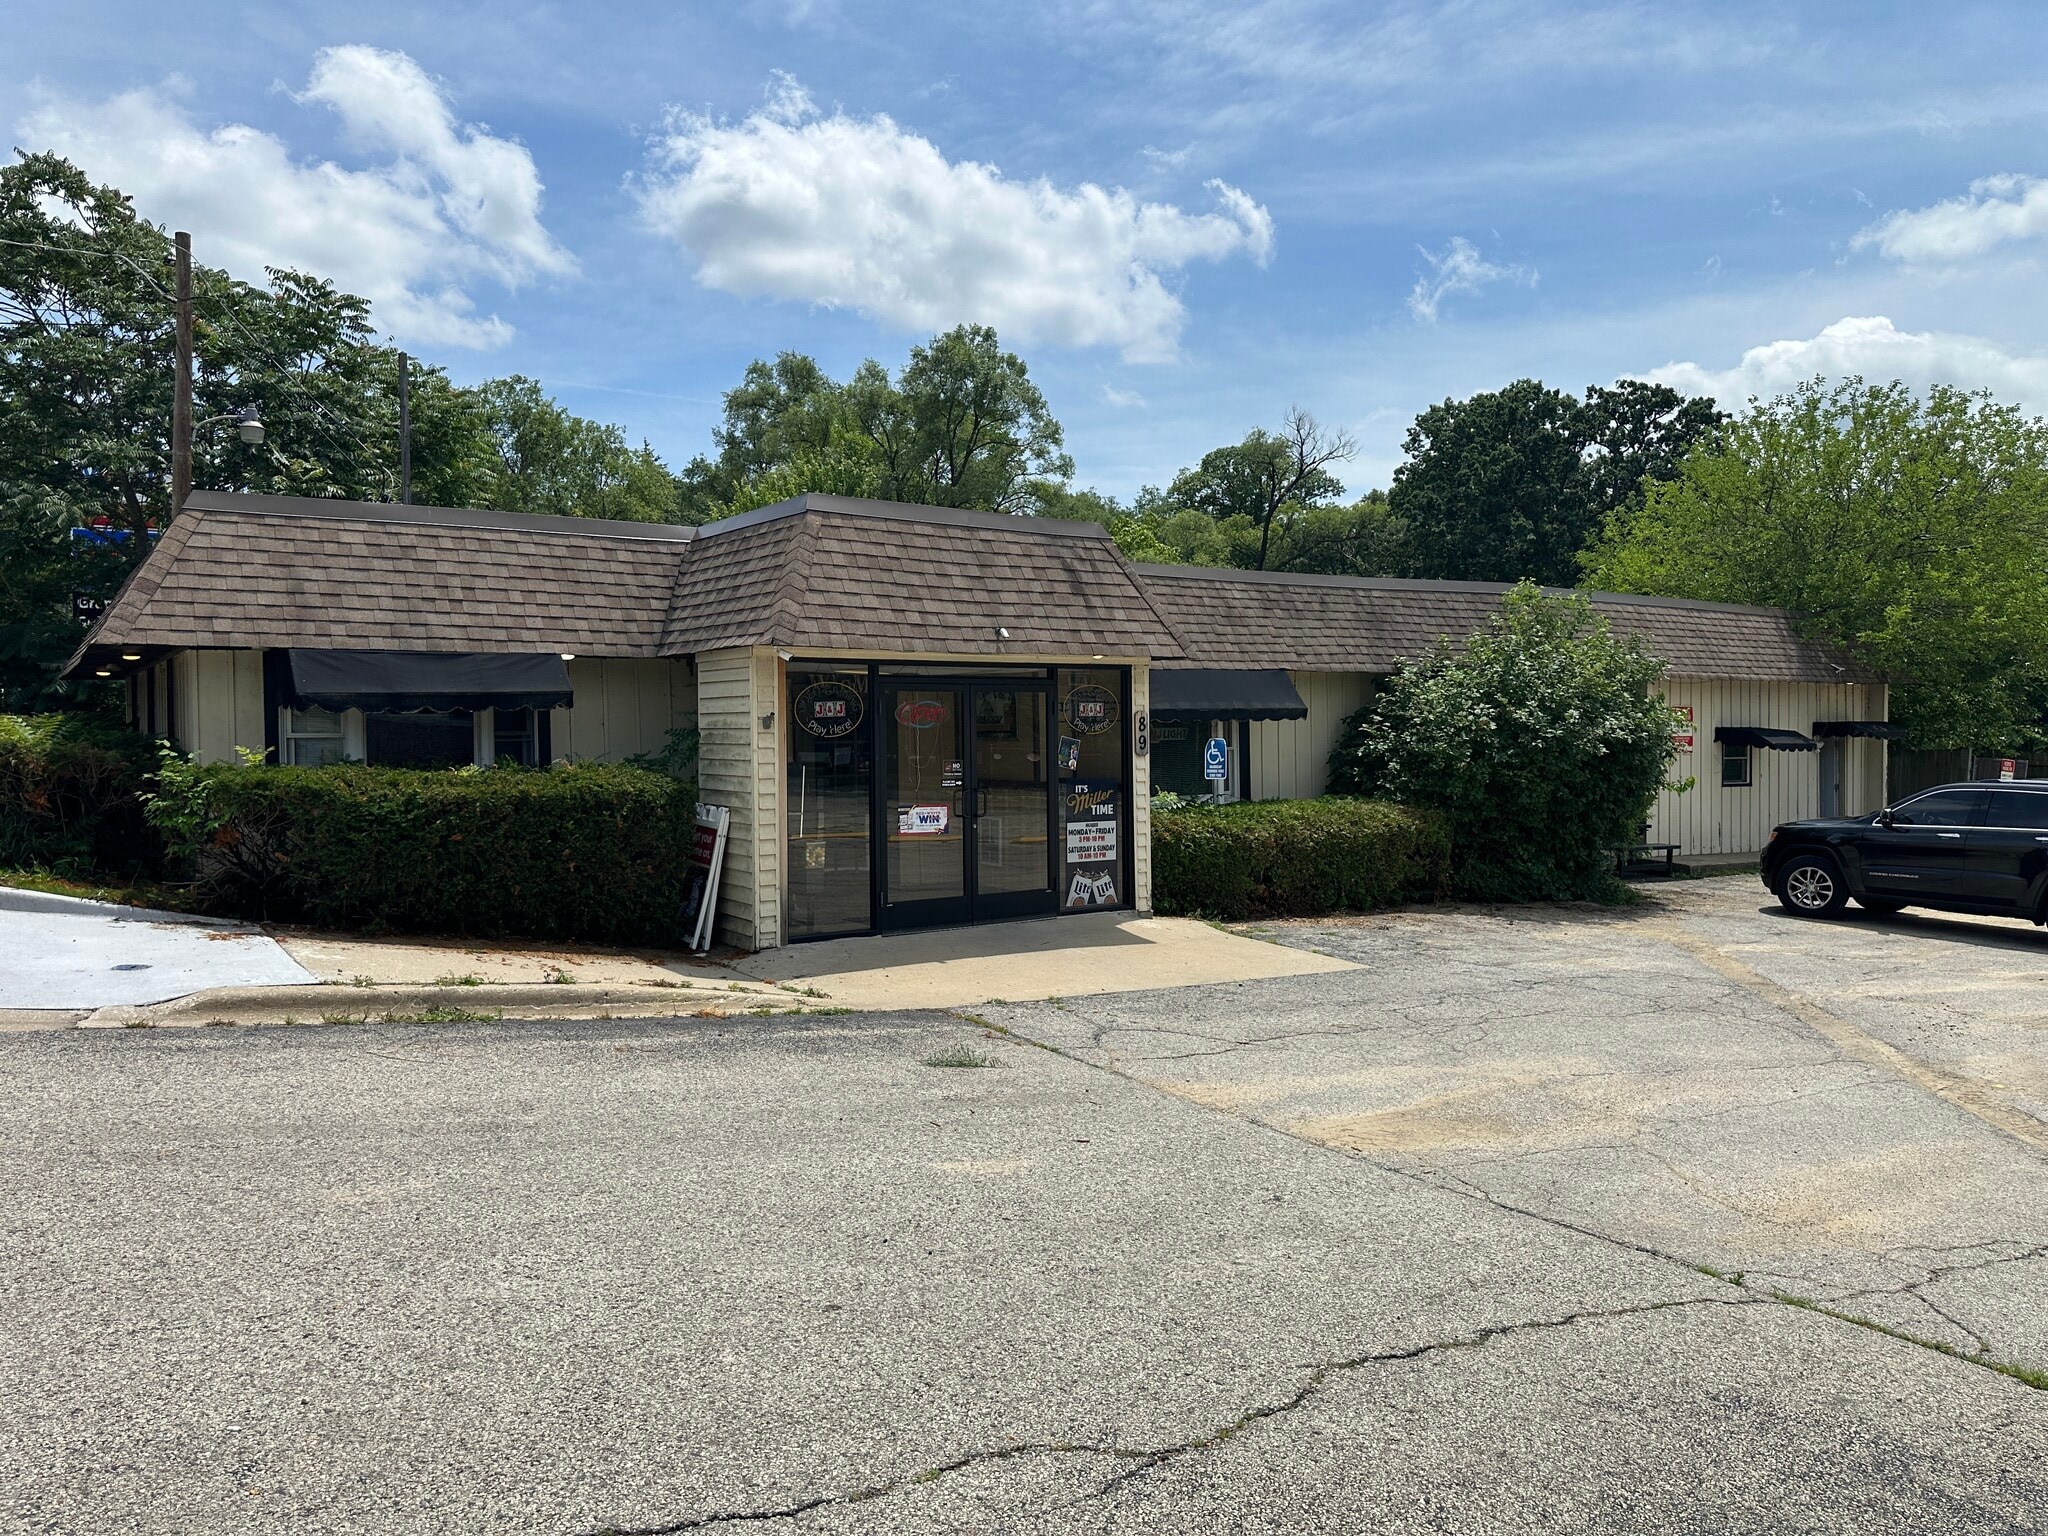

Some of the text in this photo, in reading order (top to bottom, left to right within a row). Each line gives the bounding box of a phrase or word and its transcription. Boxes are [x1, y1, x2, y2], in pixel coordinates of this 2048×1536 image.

[807, 718, 853, 736] Play Here!
[1073, 718, 1111, 732] Play Here!
[1138, 716, 1147, 750] 89
[1075, 784, 1088, 793] IT'S
[1066, 789, 1114, 815] Miller
[1091, 804, 1114, 815] TIME
[918, 814, 940, 824] WIN
[1097, 844, 1115, 852] SUNDAY
